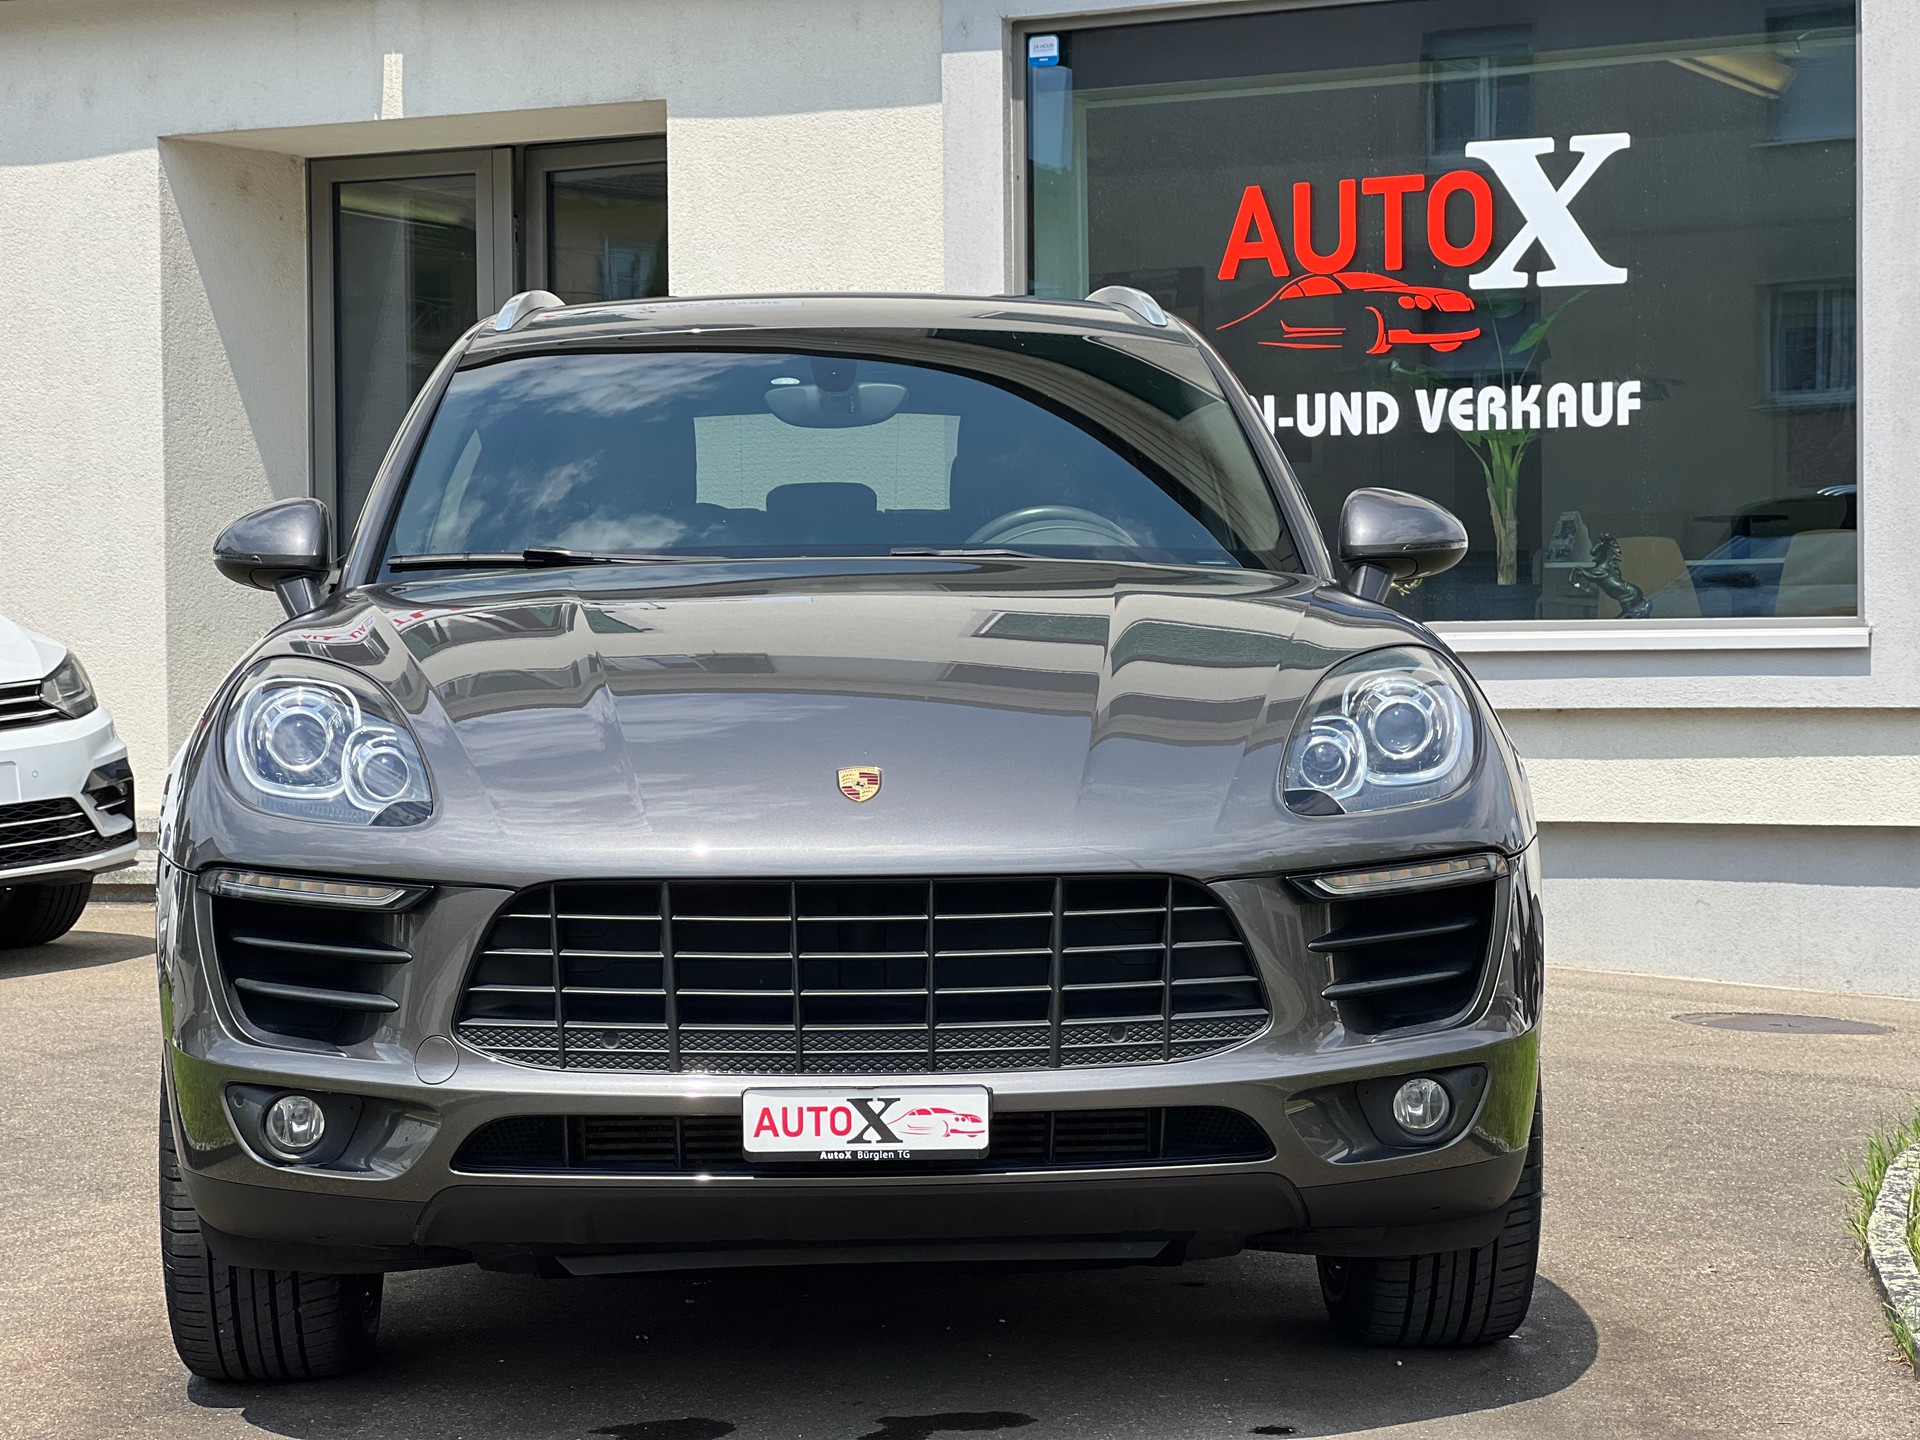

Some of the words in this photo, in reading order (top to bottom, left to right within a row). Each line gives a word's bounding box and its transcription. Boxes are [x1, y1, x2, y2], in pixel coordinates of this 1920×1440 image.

[1414, 381, 1641, 434] VERKAUF
[820, 1150, 852, 1160] AutoX
[857, 1150, 895, 1161] Bürglen
[897, 1150, 911, 1159] TG
